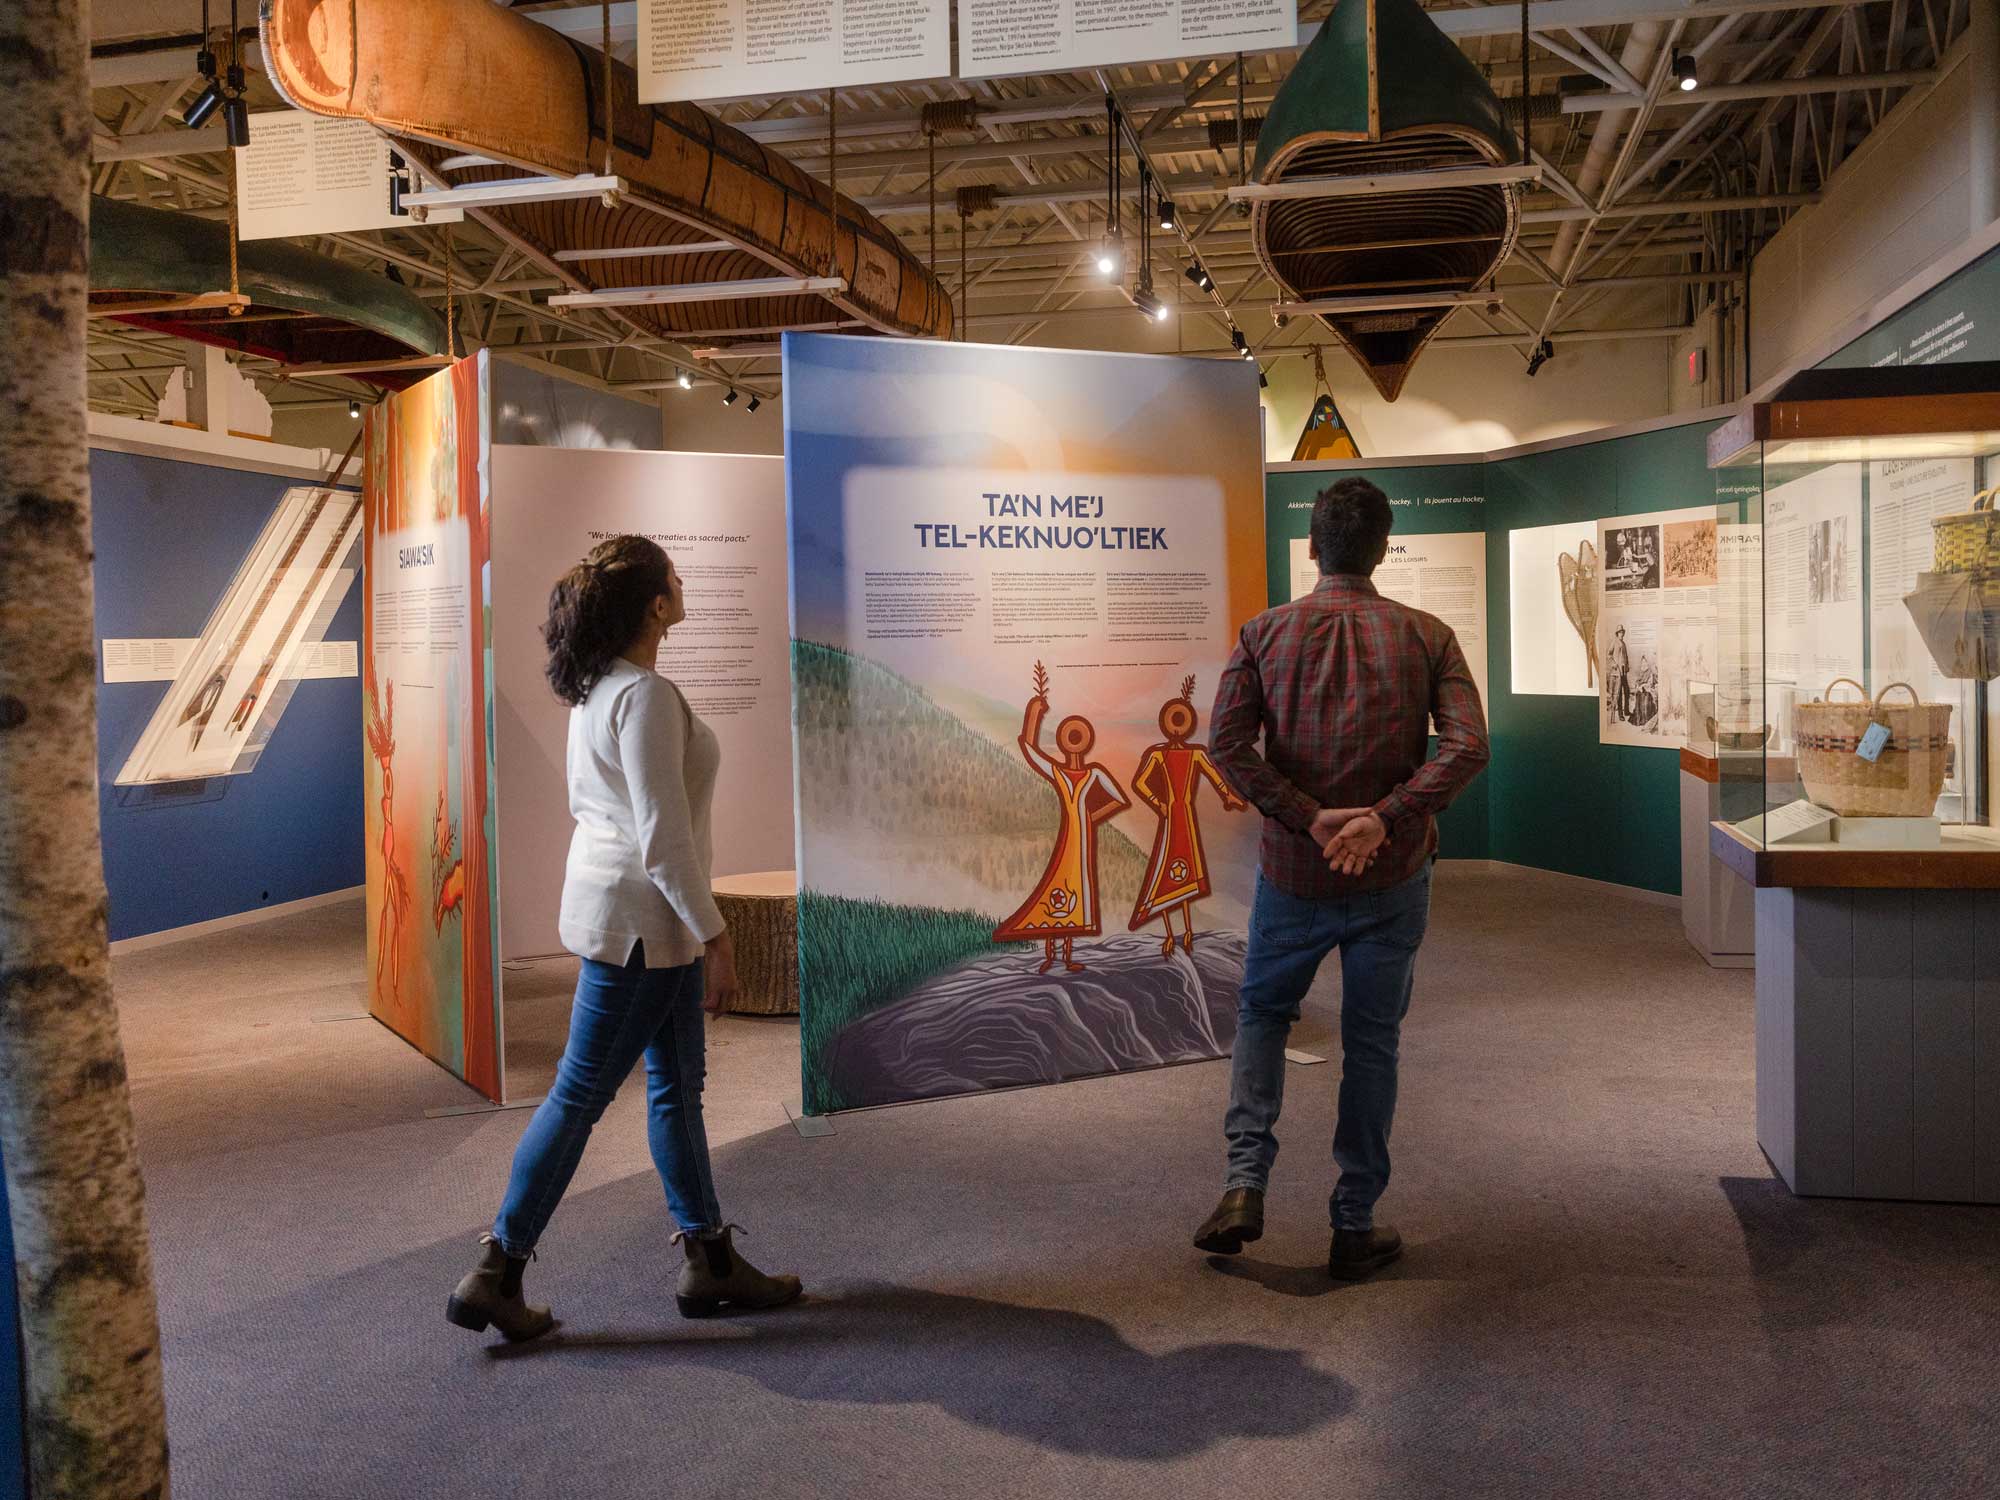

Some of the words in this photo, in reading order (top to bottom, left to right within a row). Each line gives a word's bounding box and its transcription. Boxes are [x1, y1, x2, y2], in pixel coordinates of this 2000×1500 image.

[982, 494, 1042, 517] TA'N
[1050, 495, 1104, 518] ME'J
[1390, 498, 1412, 506] hockey.
[1462, 496, 1486, 504] hockey.
[699, 534, 723, 542] sacred
[914, 524, 1168, 550] TEL-KEKNUO'LTIEK
[400, 544, 434, 569] SIAWA'SIK
